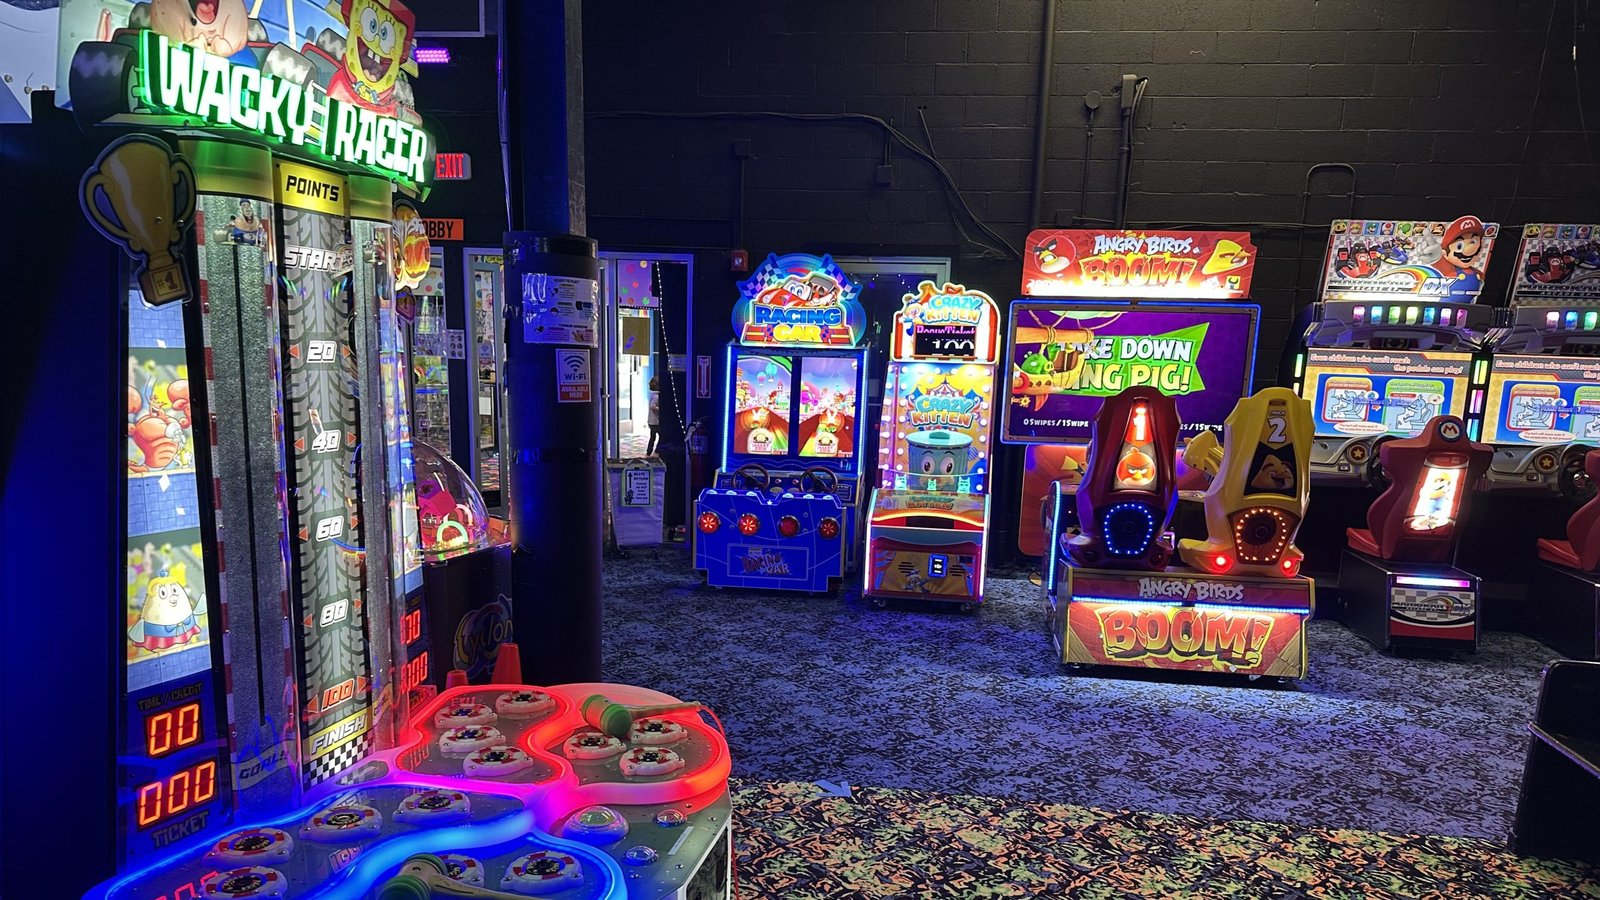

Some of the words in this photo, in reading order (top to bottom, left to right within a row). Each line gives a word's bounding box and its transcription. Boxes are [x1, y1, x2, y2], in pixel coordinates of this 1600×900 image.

[159, 43, 314, 147] WACKY
[333, 99, 428, 183] RACER
[436, 153, 464, 178] EXIT
[286, 175, 339, 203] POINTS
[422, 221, 455, 238] OBBY
[1093, 235, 1145, 255] ANGRY
[1144, 236, 1193, 254] BIRDS
[1080, 256, 1198, 289] BOOM!
[930, 295, 983, 310] CRAZY
[754, 306, 842, 325] RACING
[926, 308, 980, 323] KITTEN
[772, 324, 822, 342] CAR
[307, 340, 337, 363] 20
[1121, 339, 1193, 362] DOWN
[1310, 353, 1328, 362] Even
[1328, 354, 1357, 362] children
[1357, 355, 1372, 363] who
[1373, 356, 1390, 364] can't
[1390, 357, 1411, 365] reach
[1393, 364, 1406, 372] the
[1406, 365, 1430, 374] pedals
[1430, 366, 1445, 374] can
[1444, 366, 1464, 375] play!
[1495, 360, 1514, 368] Even
[1514, 361, 1545, 369] children
[1544, 362, 1560, 370] who
[1560, 362, 1580, 370] can't
[1583, 371, 1597, 379] the
[1129, 364, 1193, 392] PIG!
[916, 396, 974, 413] CRAZY
[911, 410, 973, 428] KITTEN
[1133, 413, 1146, 441] 1
[1267, 416, 1287, 443] 2
[312, 430, 341, 453] 40
[316, 515, 344, 542] 60
[1138, 578, 1192, 598] ANGRY
[1194, 581, 1244, 601] BIRDS
[320, 599, 348, 627] 80
[1100, 608, 1272, 666] BOOM!
[138, 695, 162, 711] TIME
[170, 682, 204, 700] CREDIT
[322, 678, 355, 712] 100
[149, 703, 199, 756] 00
[312, 715, 367, 754] FINISH
[139, 761, 216, 827] 000
[152, 810, 209, 848] TICKET
